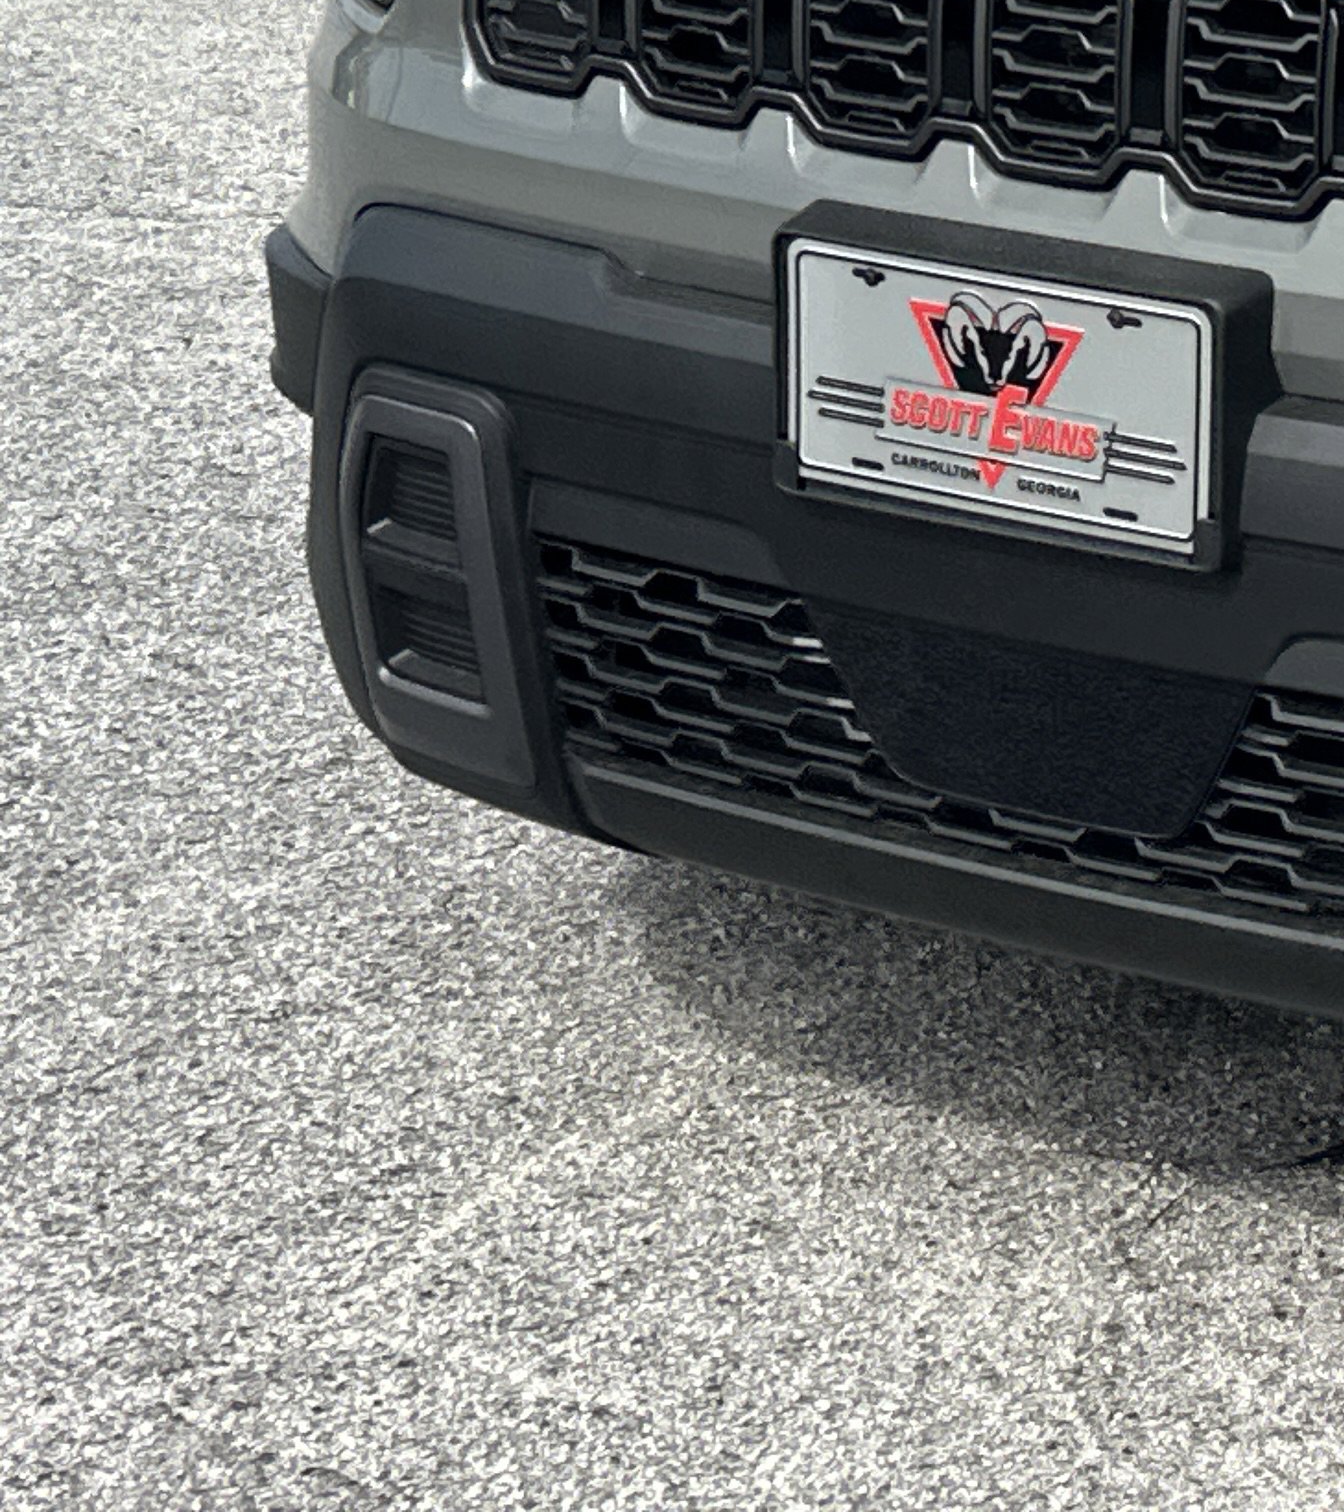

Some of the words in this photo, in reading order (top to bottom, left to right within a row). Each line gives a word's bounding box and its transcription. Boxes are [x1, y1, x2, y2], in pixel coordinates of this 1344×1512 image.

[890, 388, 988, 439] SCOTT
[891, 452, 981, 481] CARROLLTON
[1017, 478, 1081, 502] GEORGIA
